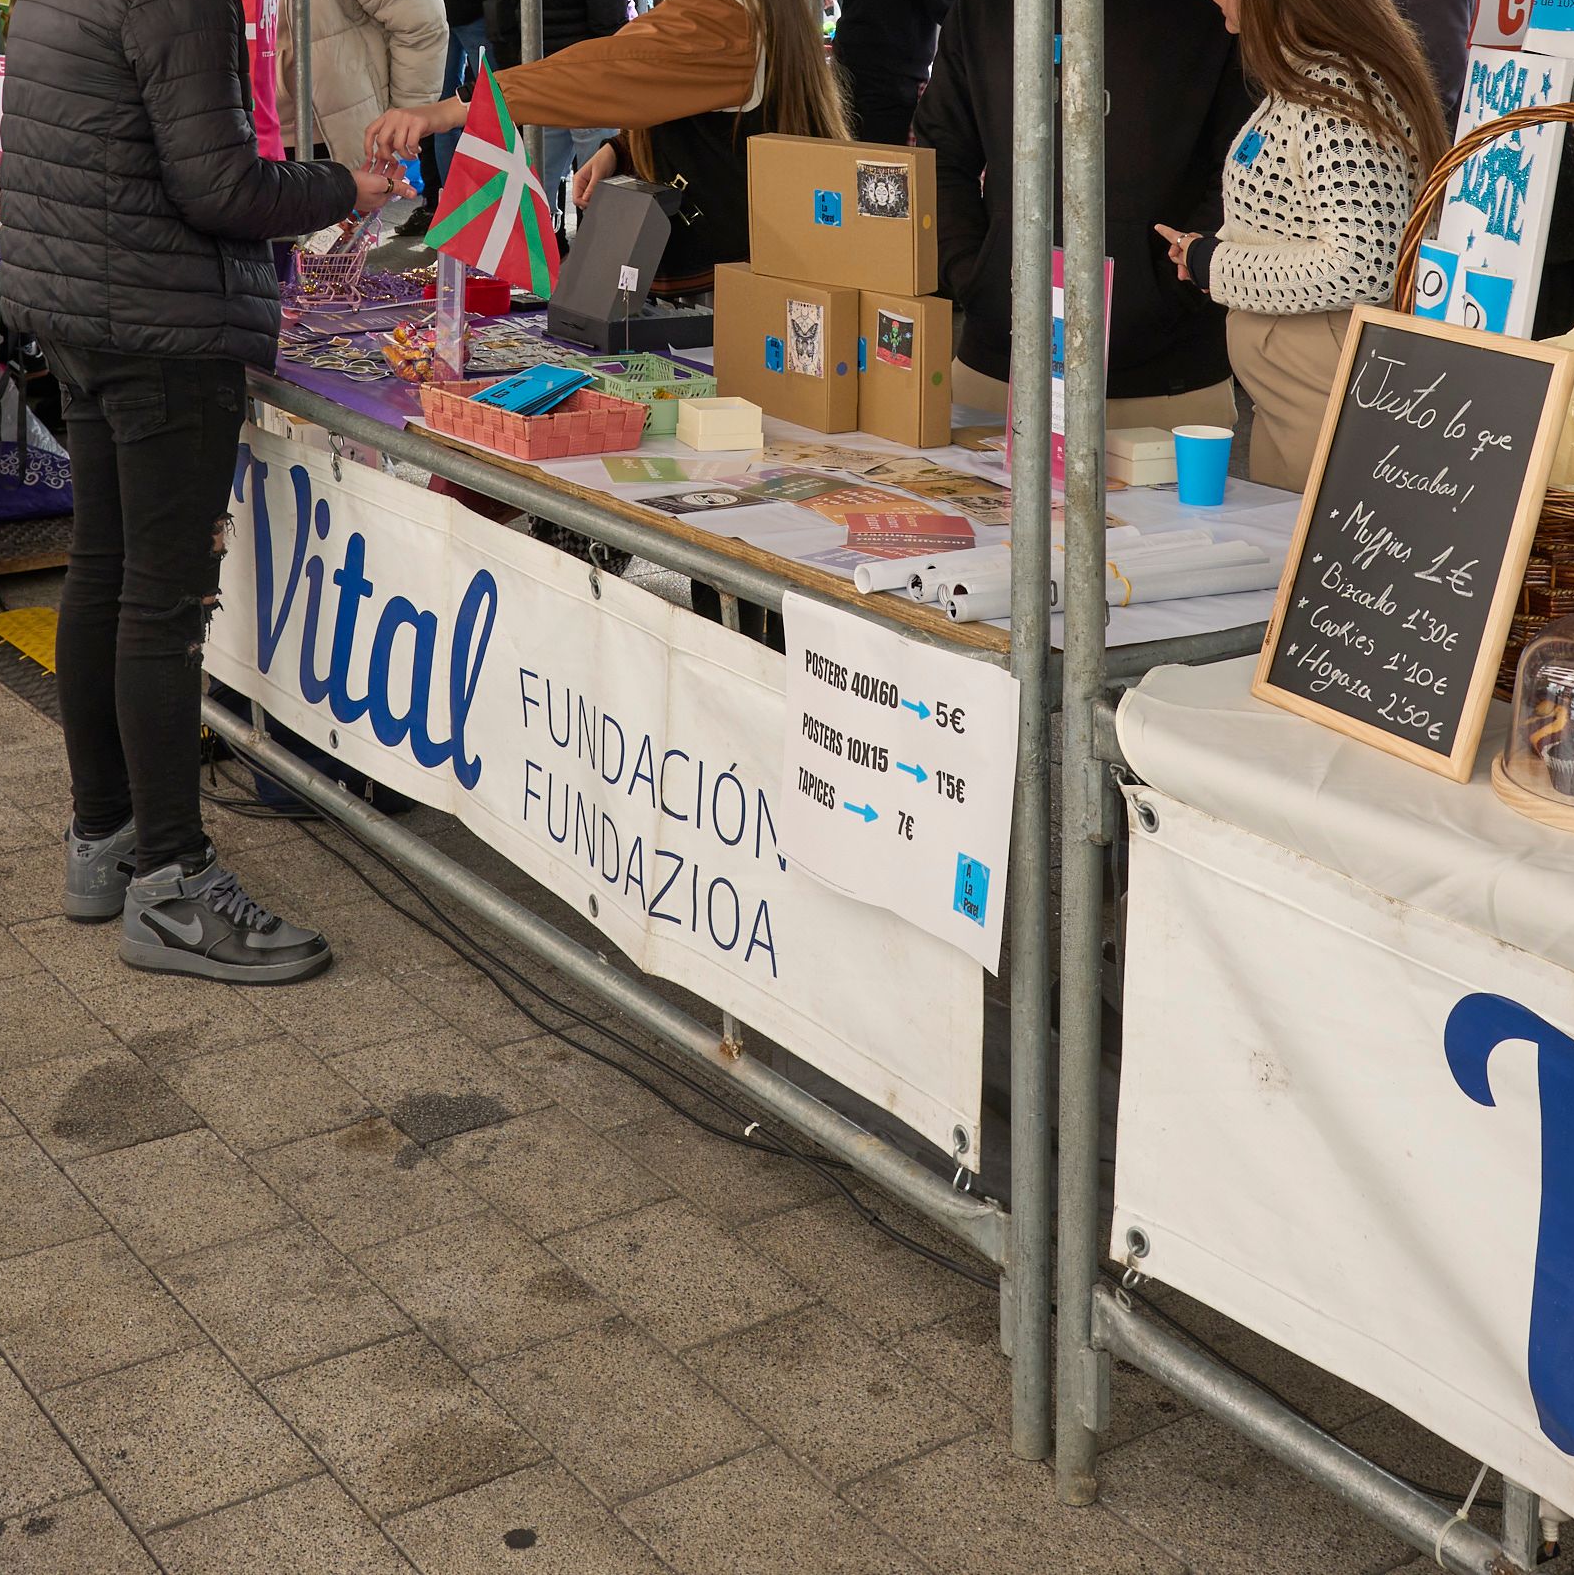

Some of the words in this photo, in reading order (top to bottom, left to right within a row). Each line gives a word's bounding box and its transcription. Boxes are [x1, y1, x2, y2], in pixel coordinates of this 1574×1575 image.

[1443, 399, 1472, 441] lo
[1471, 427, 1513, 460] que
[1341, 501, 1412, 570] Muffins
[233, 443, 500, 792] Vital
[1320, 561, 1397, 617] Bizcocho
[805, 649, 848, 692] POSTERS
[850, 672, 898, 709] 40X60
[935, 701, 966, 735] 5€
[1297, 642, 1373, 703] Hogaza
[802, 712, 843, 757] POSTERS
[846, 736, 889, 773] 10X15
[797, 766, 836, 810] TAPICES
[897, 810, 915, 841] 7€
[521, 761, 781, 979] FUNDAZIOA
[964, 882, 973, 896] La
